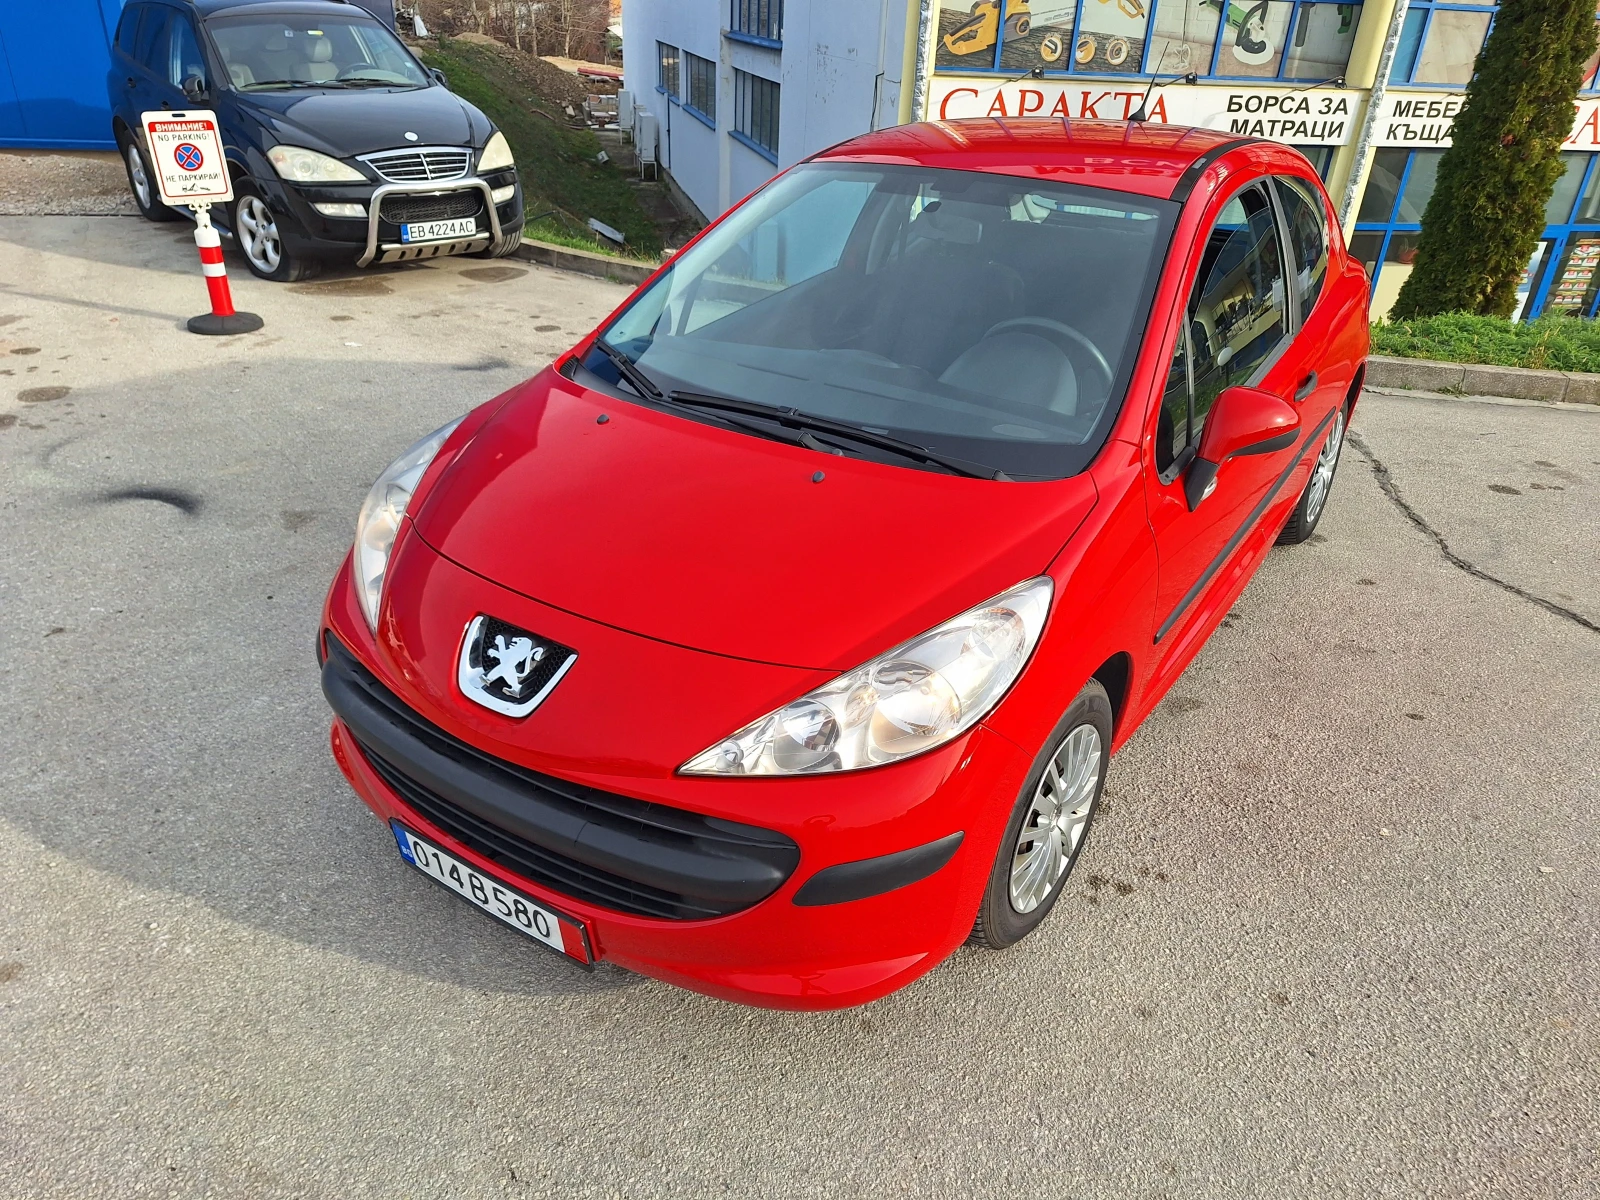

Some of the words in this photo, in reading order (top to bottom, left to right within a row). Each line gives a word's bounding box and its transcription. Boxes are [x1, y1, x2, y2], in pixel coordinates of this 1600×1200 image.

[1226, 94, 1310, 115] БОРСА
[1317, 97, 1349, 115] ЗА
[155, 122, 208, 132] ВНИМАНИЕ!
[1230, 118, 1345, 142] МАТРАЦИ
[157, 134, 170, 142] NO
[172, 132, 211, 141] PARKING!
[165, 174, 177, 182] НЕ
[409, 225, 426, 239] EB
[428, 222, 456, 237] 4224
[459, 220, 473, 234] AC
[412, 840, 550, 938] 014B580
